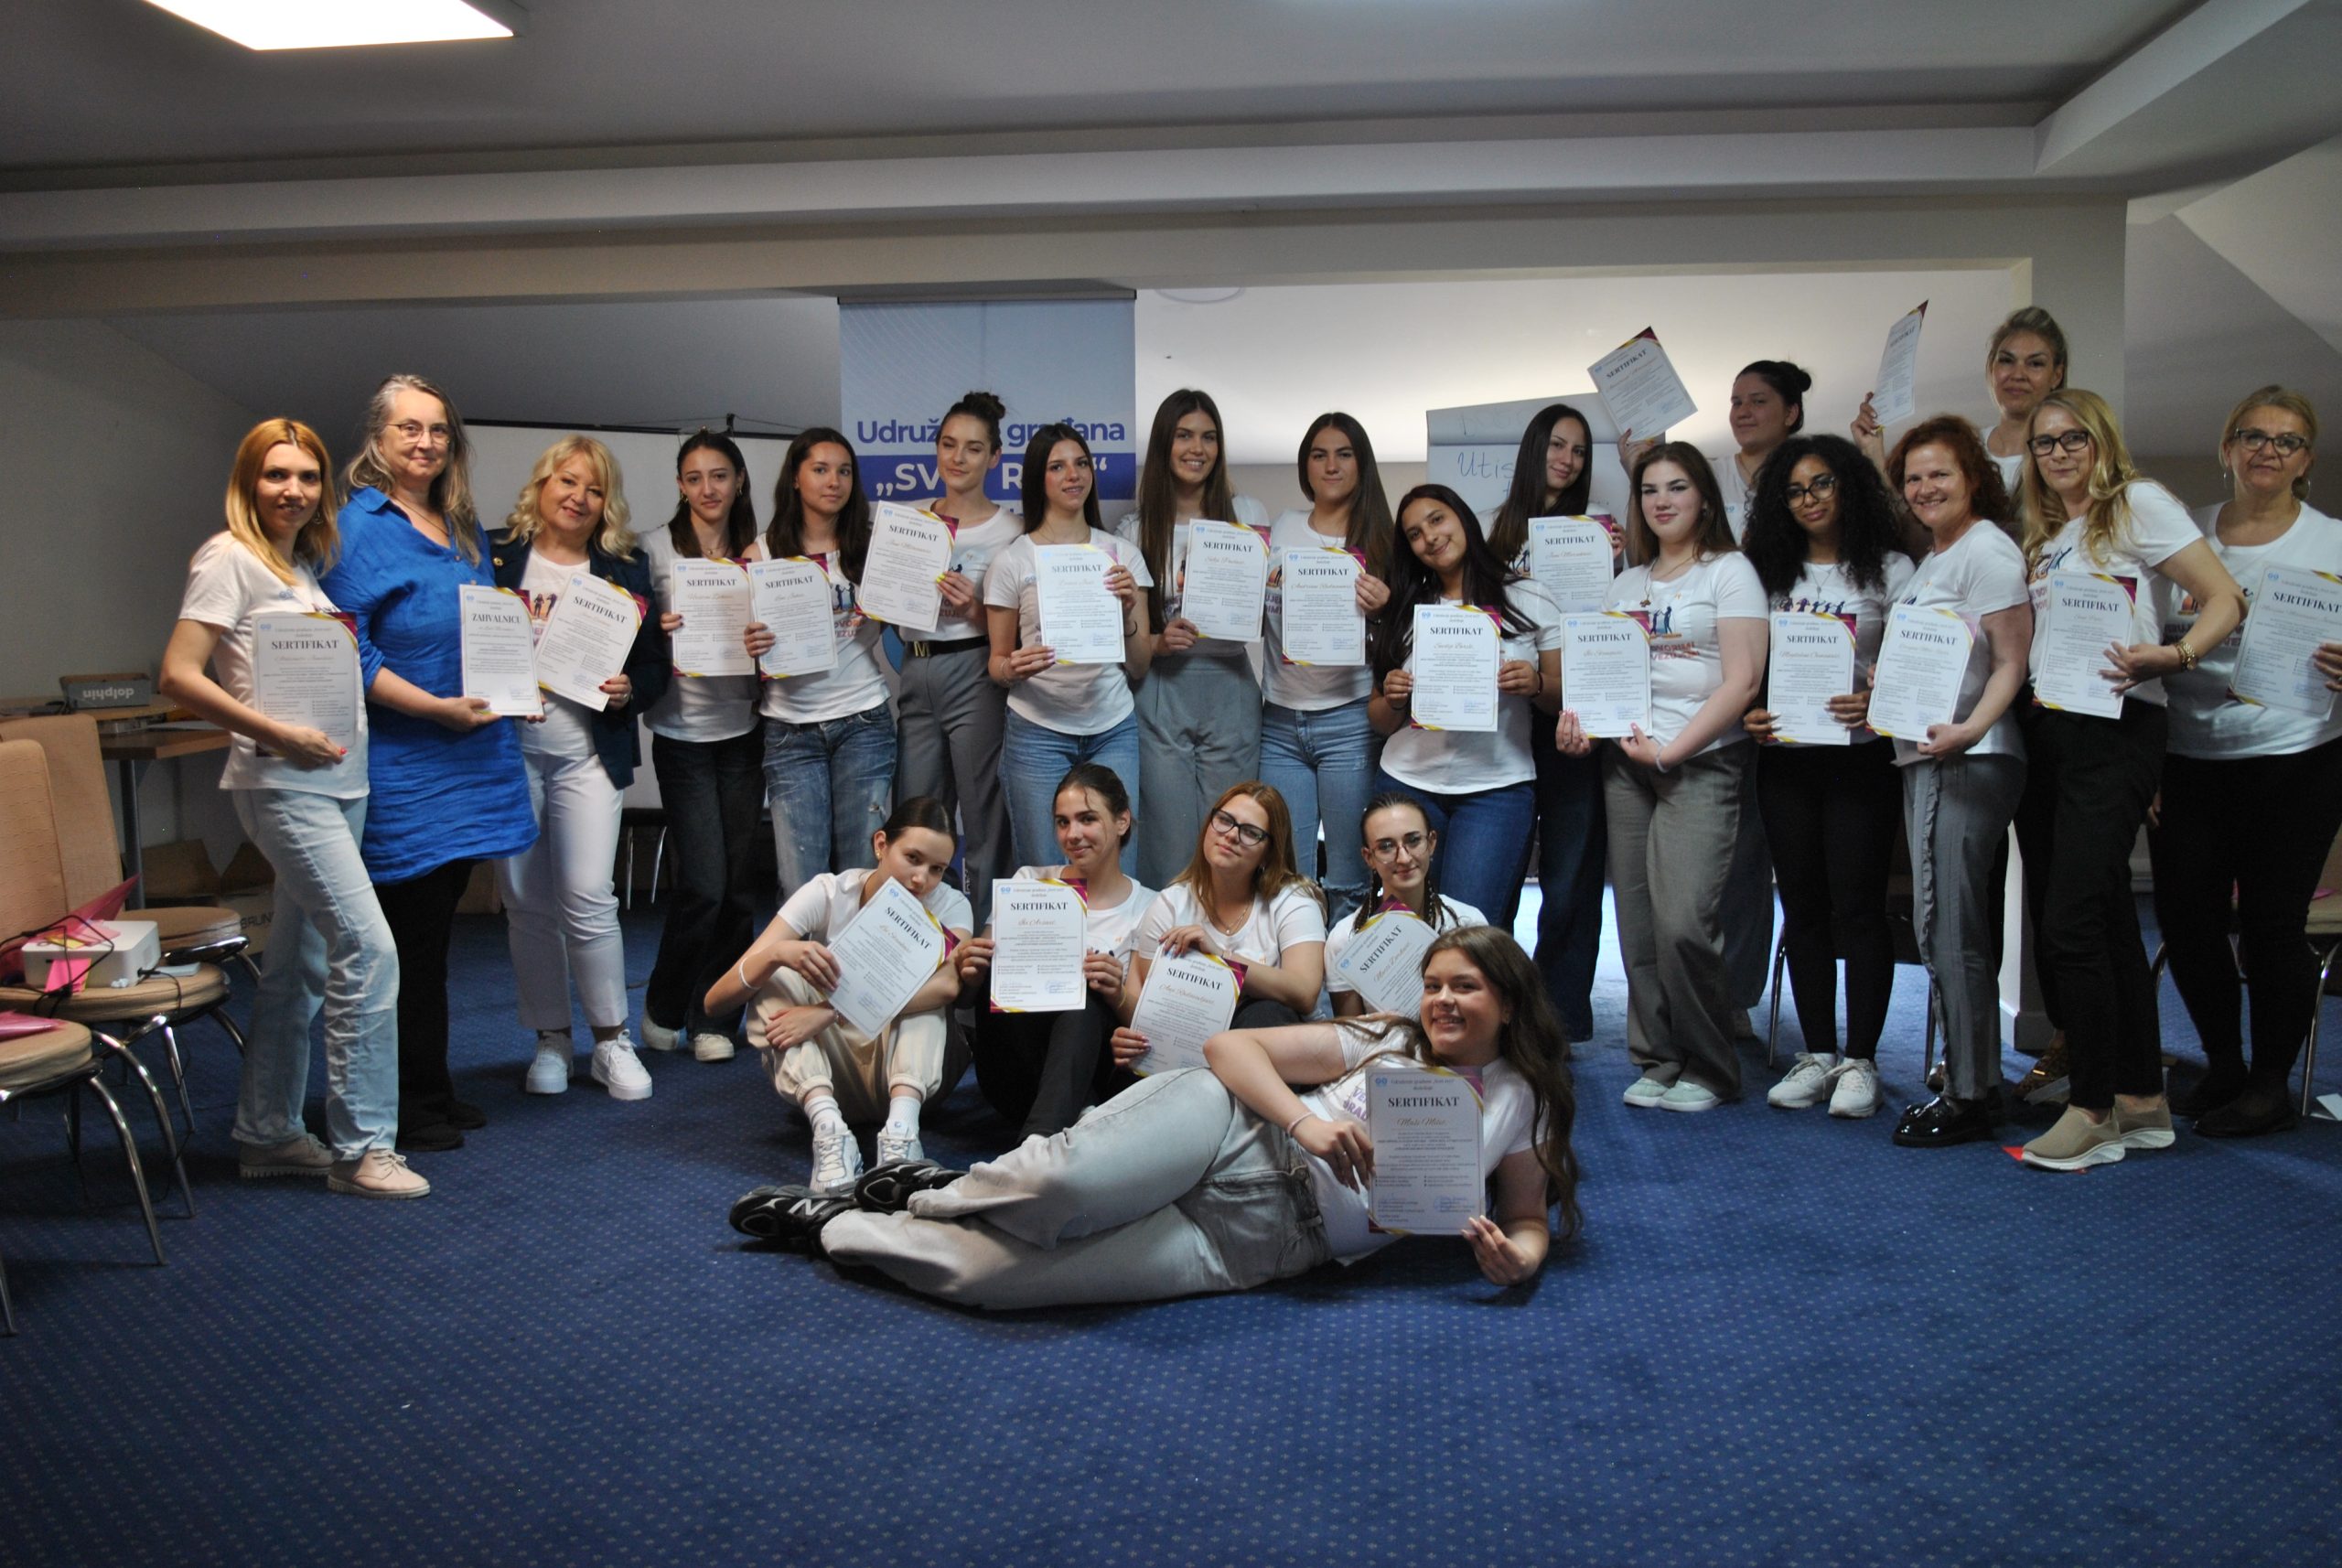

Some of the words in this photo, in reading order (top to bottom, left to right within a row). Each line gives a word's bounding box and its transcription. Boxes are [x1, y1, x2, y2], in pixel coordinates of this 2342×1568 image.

[1606, 349, 1648, 379] SERTIFIKAT
[1007, 417, 1125, 447] grana
[1457, 452, 1515, 479] Utis
[876, 463, 941, 497] „SV
[889, 524, 939, 542] SERTIFIKAT
[1203, 541, 1253, 553] SERTIFIKAT
[1545, 535, 1595, 546] SERTIFIKAT
[1052, 564, 1102, 574] SERTIFIKAT
[1298, 568, 1349, 576] SERTIFIKAT
[687, 578, 737, 587] SERTIFIKAT
[766, 575, 814, 589] SERTIFIKAT
[2062, 597, 2120, 612] SERTIFIKAT
[2272, 591, 2342, 614] SERTIFIKAT
[574, 596, 628, 624] SERTIFIKAT
[1430, 627, 1484, 636] SERTIFIKAT
[1578, 633, 1632, 643] SERTIFIKAT
[1900, 629, 1959, 645] SERTIFIKAT
[272, 639, 339, 650] SERTIFIKAT
[1787, 635, 1839, 644] SERTIFIKAT
[82, 687, 134, 700] dolphin
[1010, 901, 1069, 911] SERTIFIKAT
[241, 911, 274, 929] BRUN
[885, 907, 932, 950] SERTIFIKAT
[1359, 925, 1402, 973] SERTIFIKAT
[1166, 968, 1223, 990] SERTIFIKAT
[1388, 1097, 1460, 1108] SERTIFIKAT
